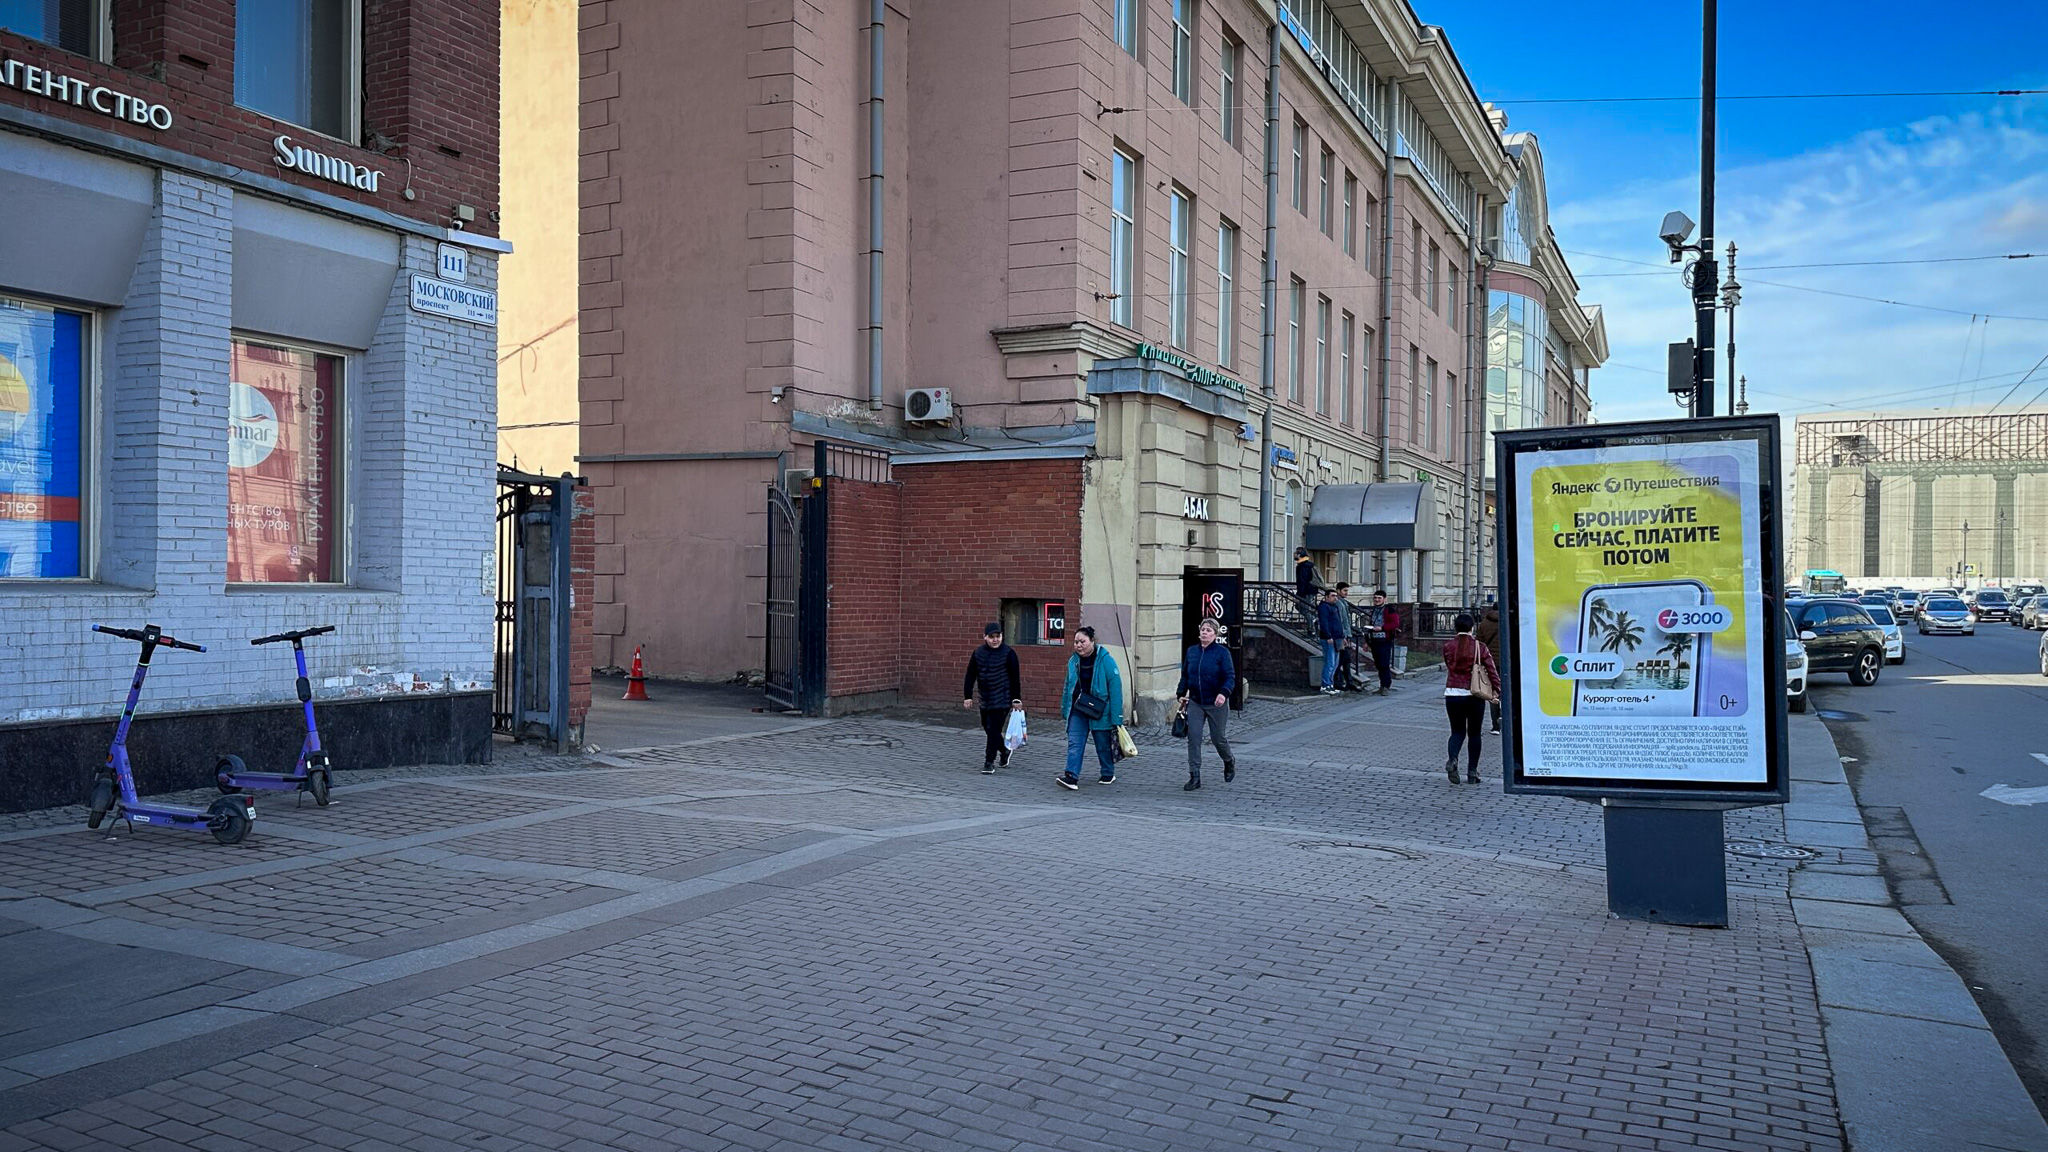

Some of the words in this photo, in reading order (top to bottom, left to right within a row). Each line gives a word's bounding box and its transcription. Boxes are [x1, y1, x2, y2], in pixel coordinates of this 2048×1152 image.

[0, 59, 173, 130] ГЕНТСТВО
[273, 135, 385, 193] Sunmar
[443, 255, 463, 273] 111
[416, 298, 449, 311] проспект
[417, 281, 494, 311] МОСКОВСКИЙ
[1552, 482, 1601, 495] Яндекс
[1623, 475, 1720, 493] Путешествия
[1183, 496, 1209, 520] АБАК
[1574, 505, 1697, 528] БРОНИРУЙТЕ
[254, 519, 290, 531] ТУРОВ
[1554, 528, 1631, 549] СЕЙЧАС,
[1634, 526, 1720, 545] ПЛАТИТЕ
[1603, 548, 1670, 566] ПОТОМ
[1202, 592, 1224, 618] KS
[1682, 612, 1723, 625] 3000
[1573, 660, 1616, 674] Сплит
[1583, 694, 1642, 704] Курорт-отель
[1719, 694, 1738, 711] 0+
